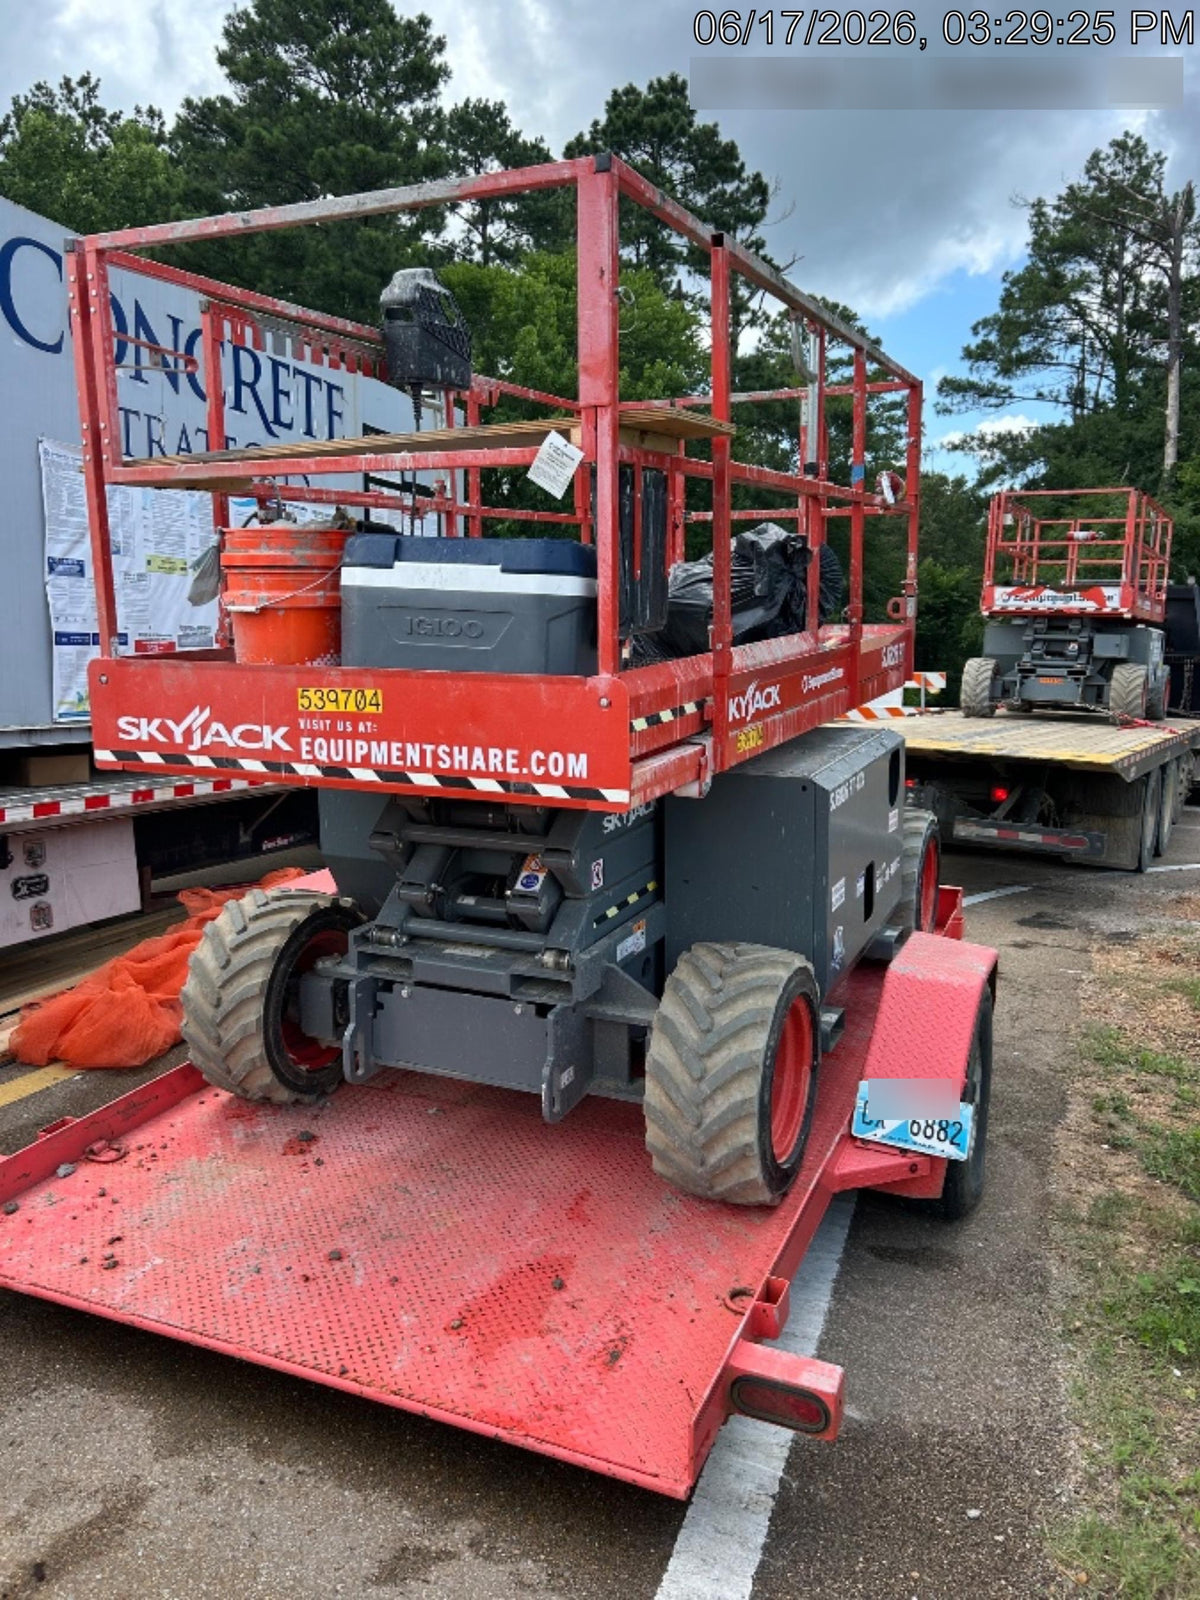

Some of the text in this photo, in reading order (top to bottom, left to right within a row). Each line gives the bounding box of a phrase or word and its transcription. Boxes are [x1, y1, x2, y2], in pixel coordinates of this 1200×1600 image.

[404, 616, 484, 639] IGLOO
[299, 687, 382, 712] 539704
[728, 679, 781, 722] KYJACK
[117, 704, 292, 752] SKYJACK
[298, 718, 378, 735] VISIT US AT:
[299, 736, 589, 780] EQUIPMENTSHARE.COM
